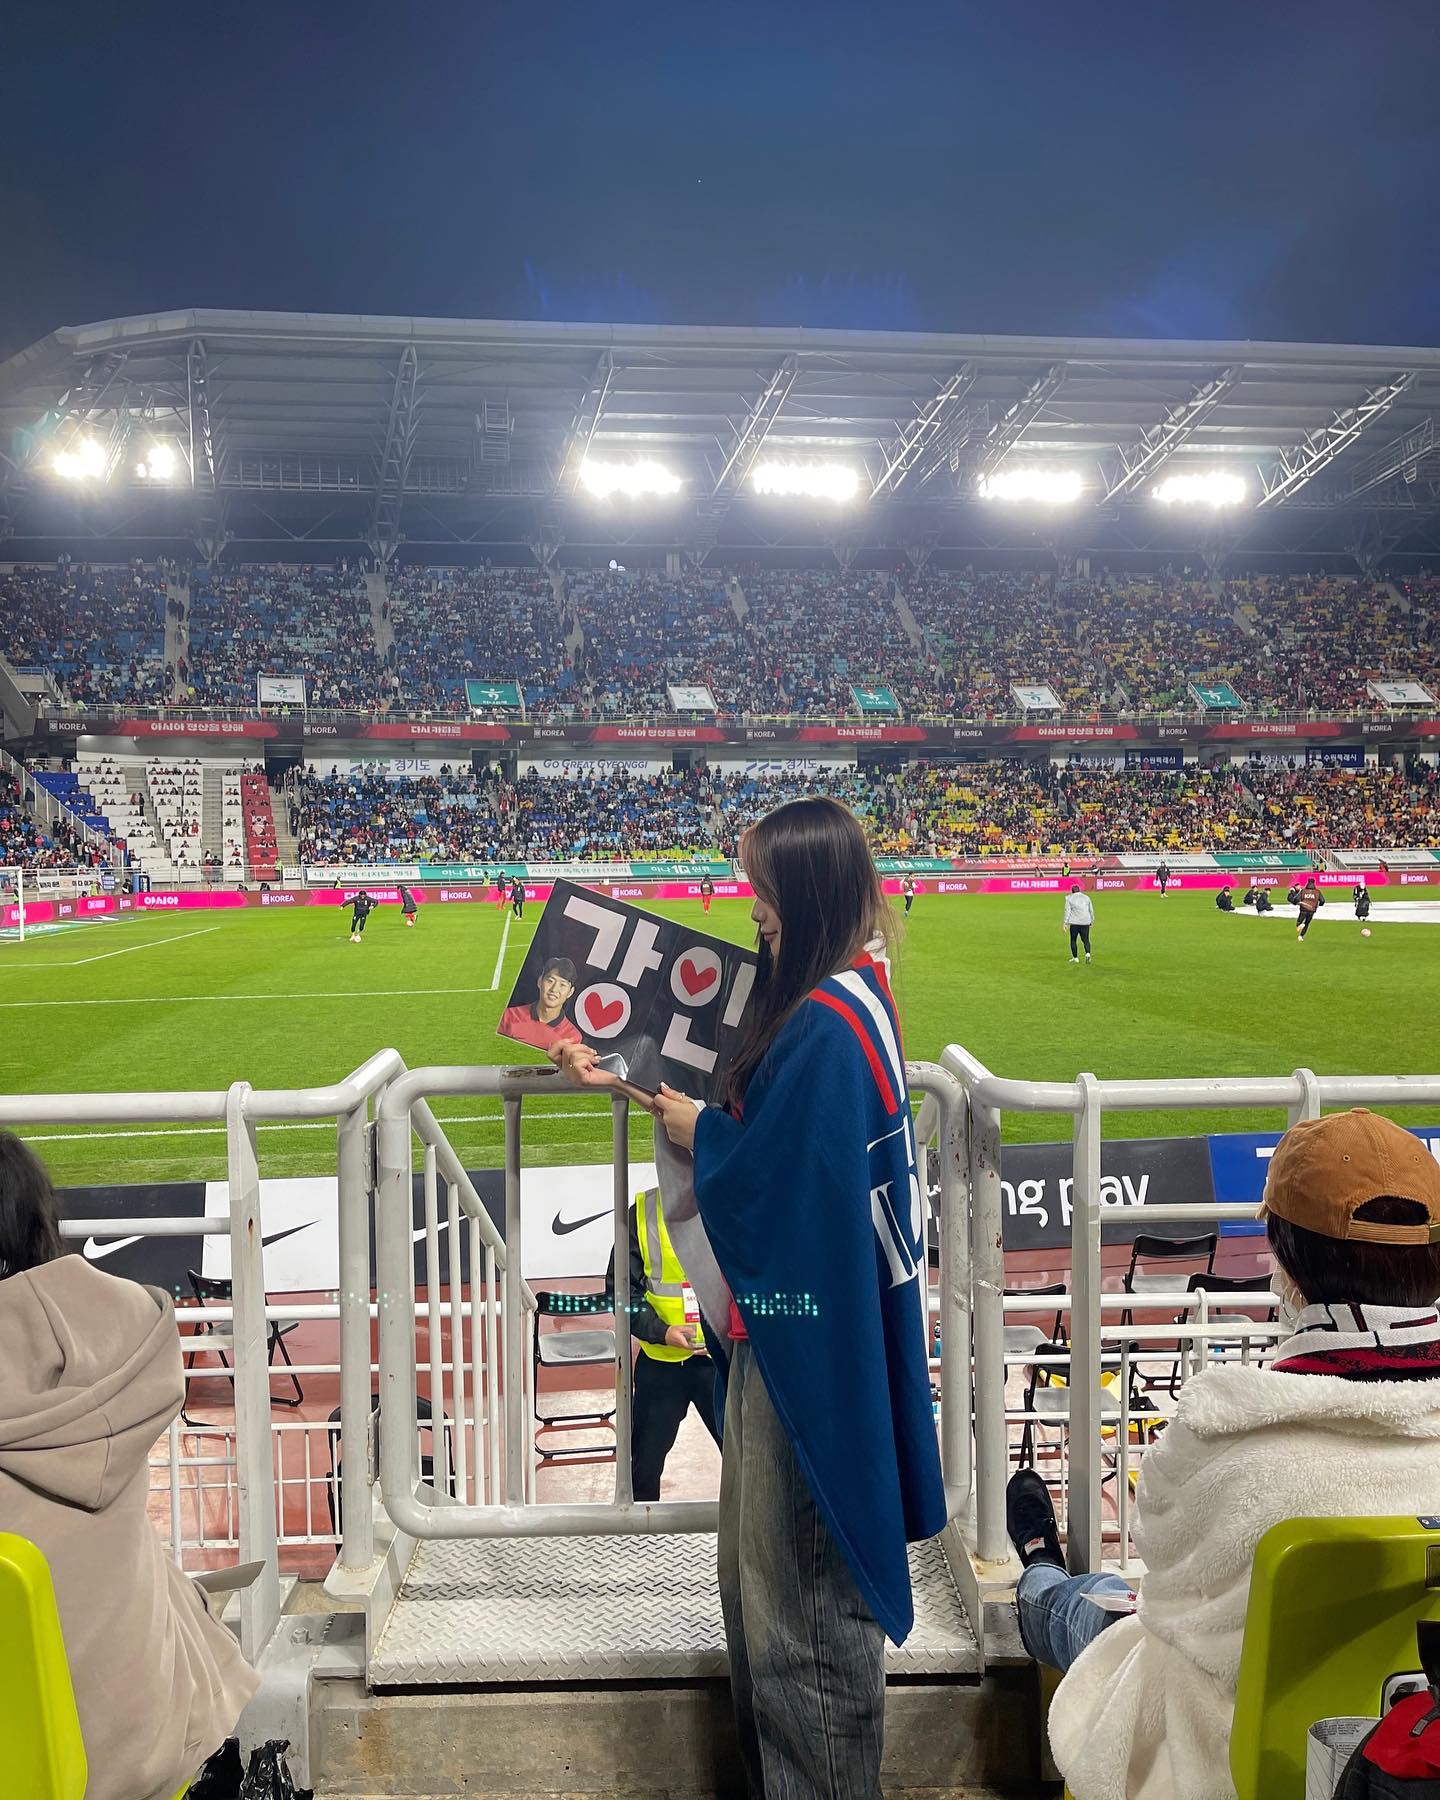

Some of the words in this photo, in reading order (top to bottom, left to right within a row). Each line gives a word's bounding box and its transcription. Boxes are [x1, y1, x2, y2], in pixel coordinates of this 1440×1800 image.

[59, 722, 87, 731] KOREA
[151, 722, 185, 731] 아시아
[312, 726, 338, 734] KOREA
[411, 726, 431, 734] 다시
[542, 729, 565, 737] KOREA
[618, 729, 646, 737] 아시아
[753, 730, 776, 738] KOREA
[1038, 728, 1065, 736] 아시아
[1166, 728, 1188, 736] KOREA
[394, 759, 431, 772] 경기도
[561, 759, 596, 769] GREAT
[786, 758, 818, 771] 경기도
[1257, 877, 1278, 885] KOREA
[448, 891, 472, 899] KOREA
[620, 888, 643, 896] KOREA
[144, 896, 179, 905] 아시아
[270, 895, 295, 903] KOREA
